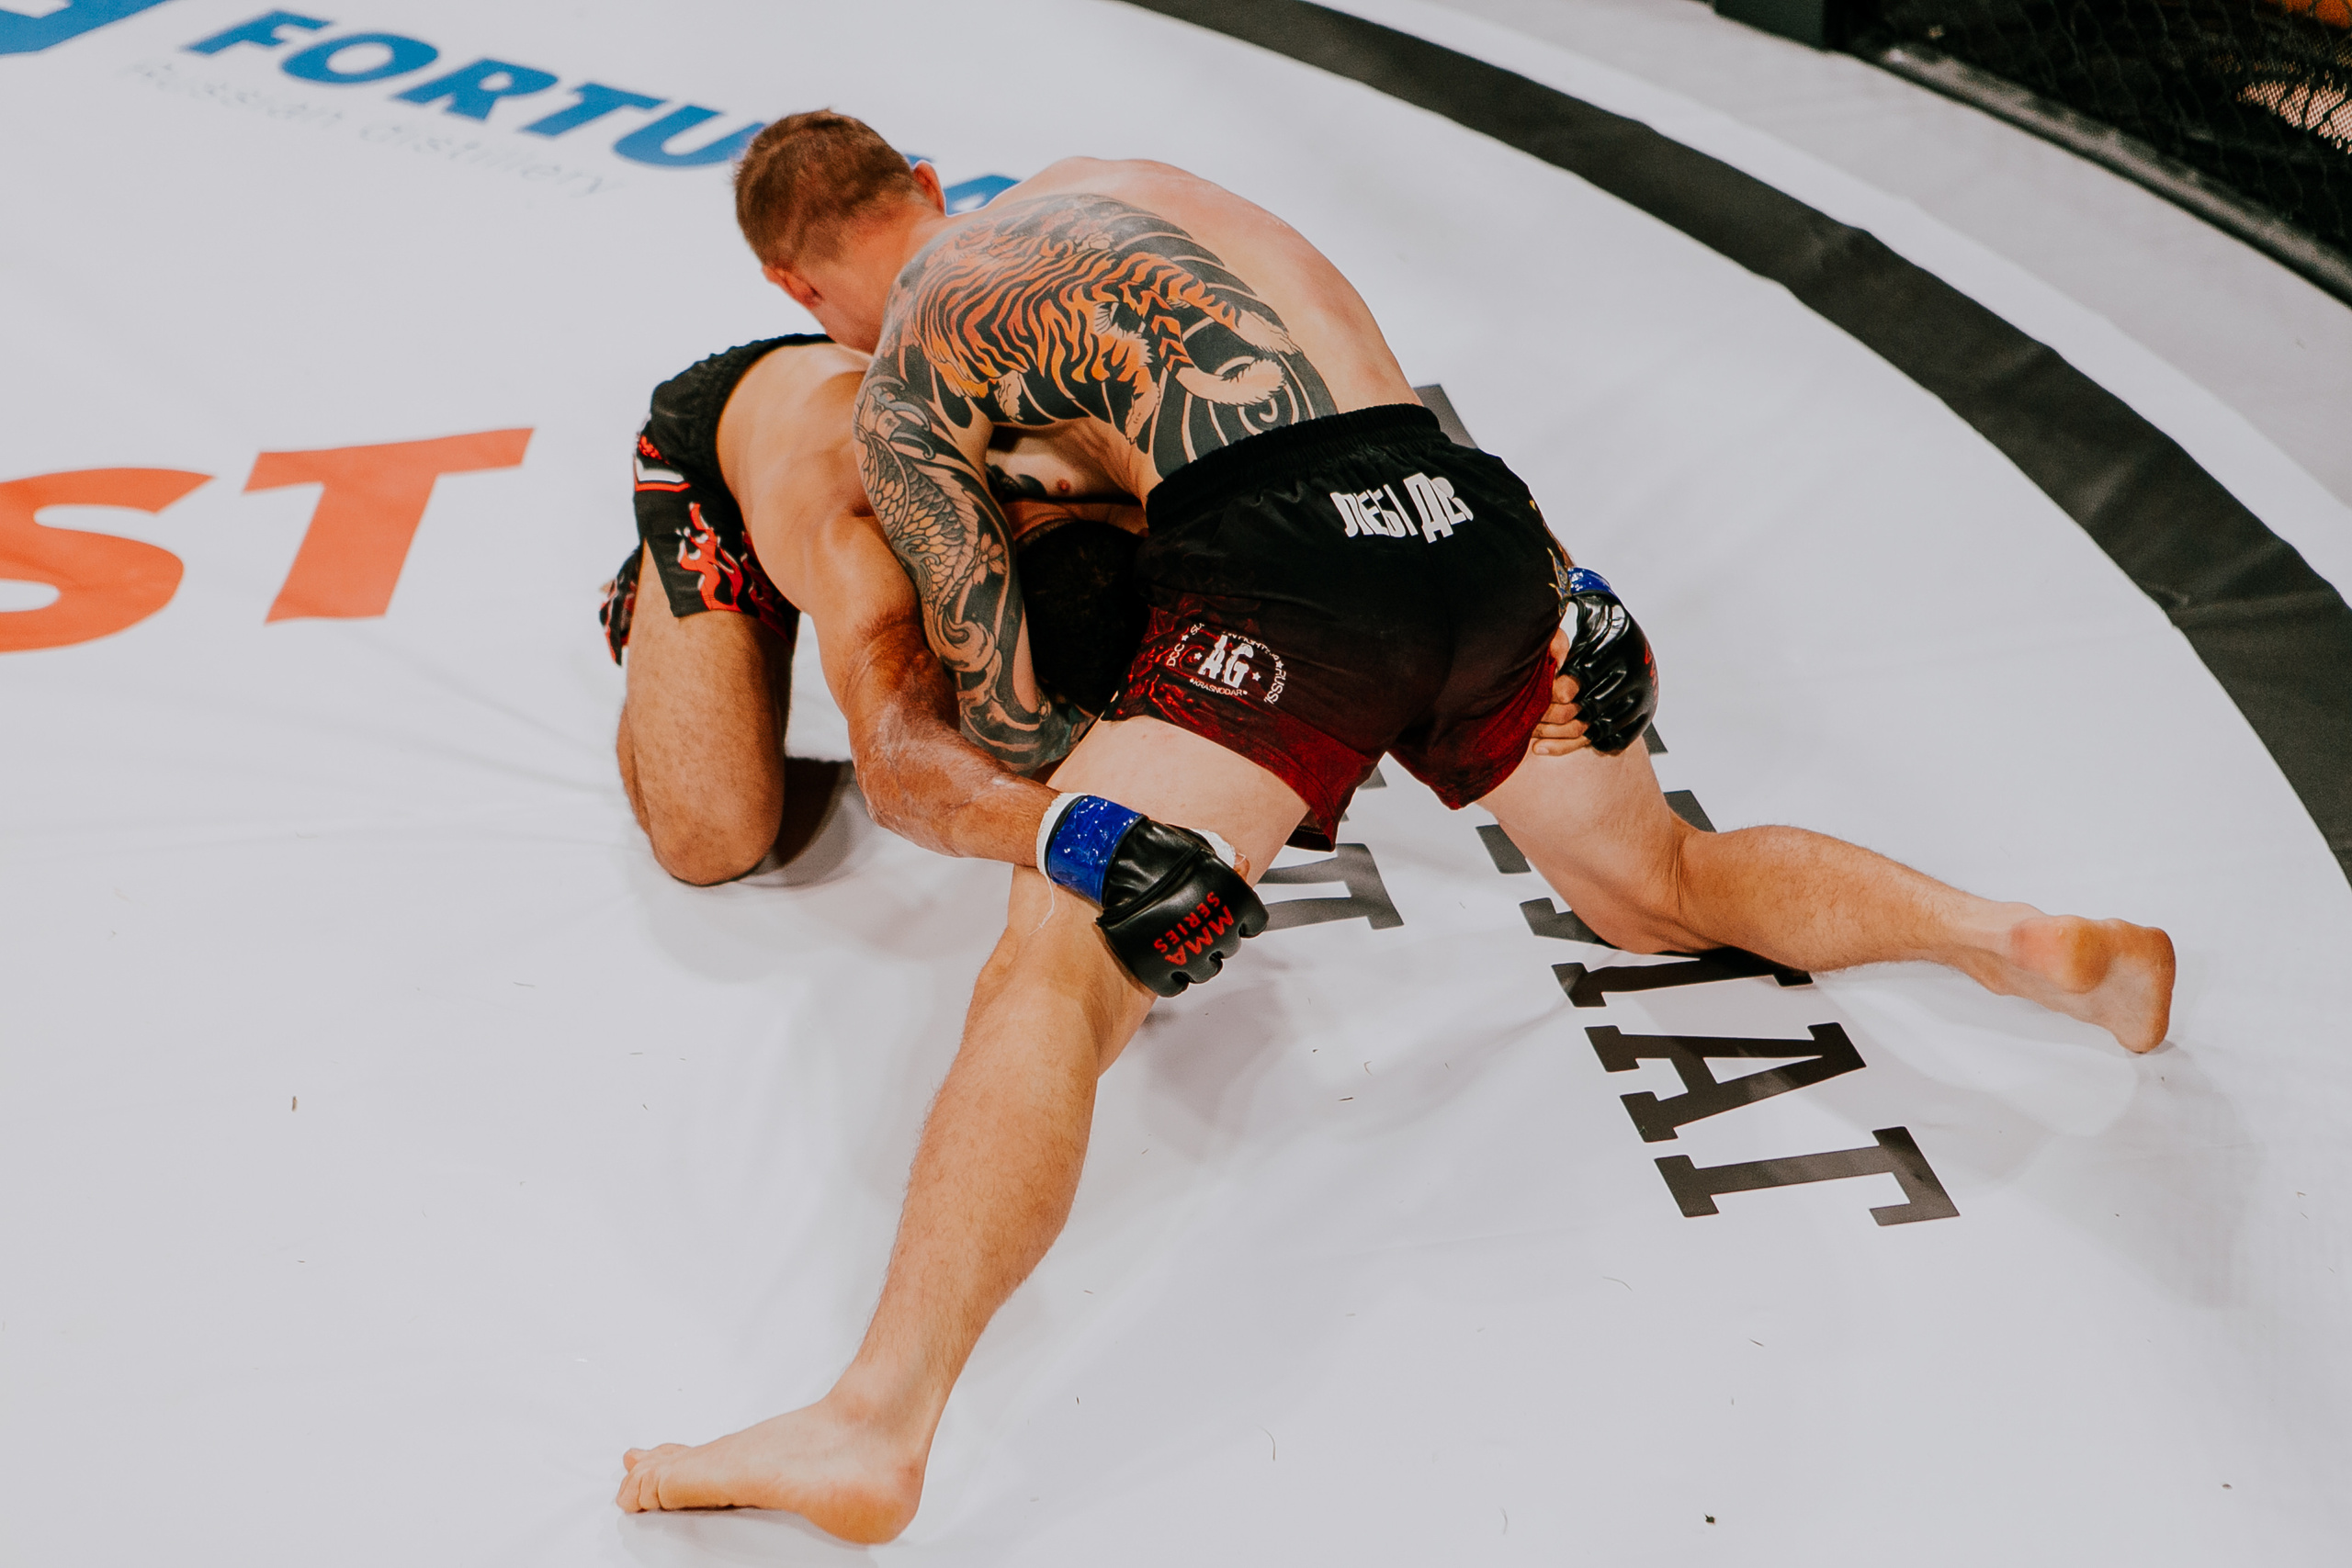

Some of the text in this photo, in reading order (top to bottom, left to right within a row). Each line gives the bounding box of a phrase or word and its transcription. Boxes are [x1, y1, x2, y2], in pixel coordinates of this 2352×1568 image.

[359, 117, 626, 199] distillery
[1193, 679, 1243, 696] KRASNODAR
[1198, 634, 1255, 689] AG
[1264, 666, 1287, 705] RUSSI
[1153, 891, 1220, 953] SERIES
[1164, 905, 1234, 966] MMA
